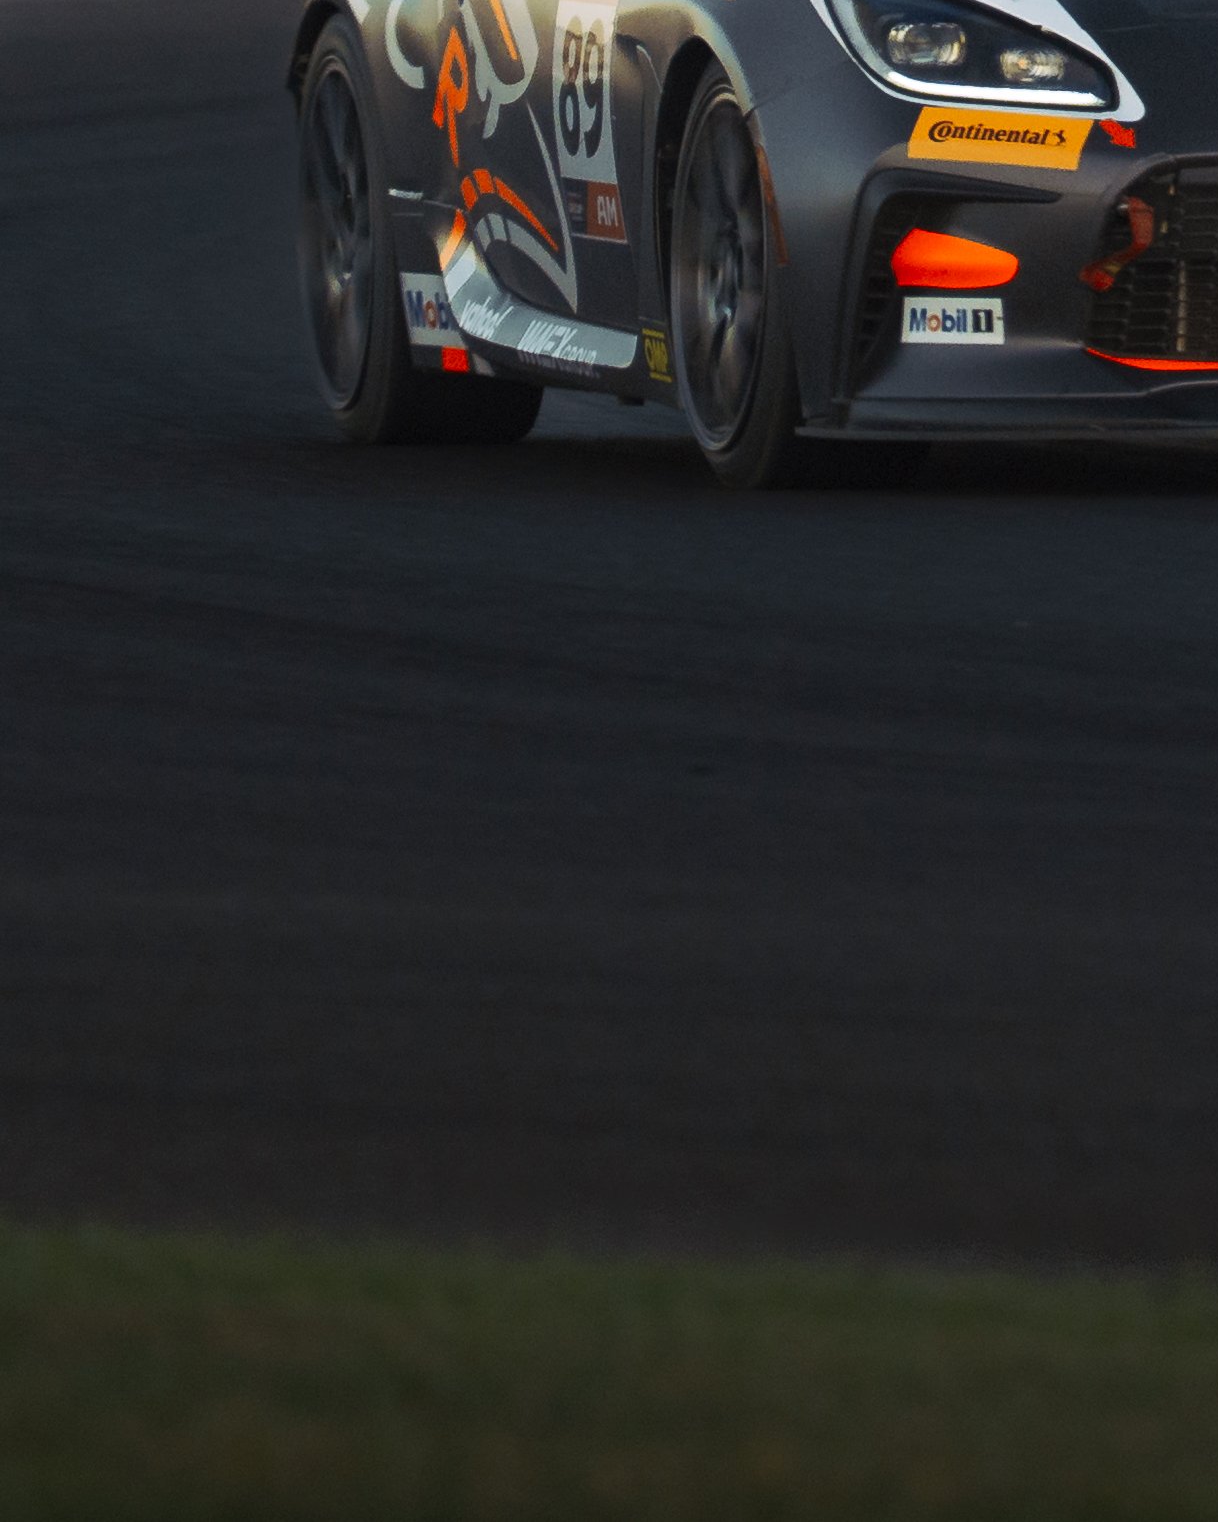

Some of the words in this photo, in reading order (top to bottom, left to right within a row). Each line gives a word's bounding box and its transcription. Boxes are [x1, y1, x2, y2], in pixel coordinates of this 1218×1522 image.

[558, 15, 605, 159] 89
[928, 120, 1049, 147] Continental
[597, 195, 619, 227] AM
[909, 307, 968, 333] Mobil
